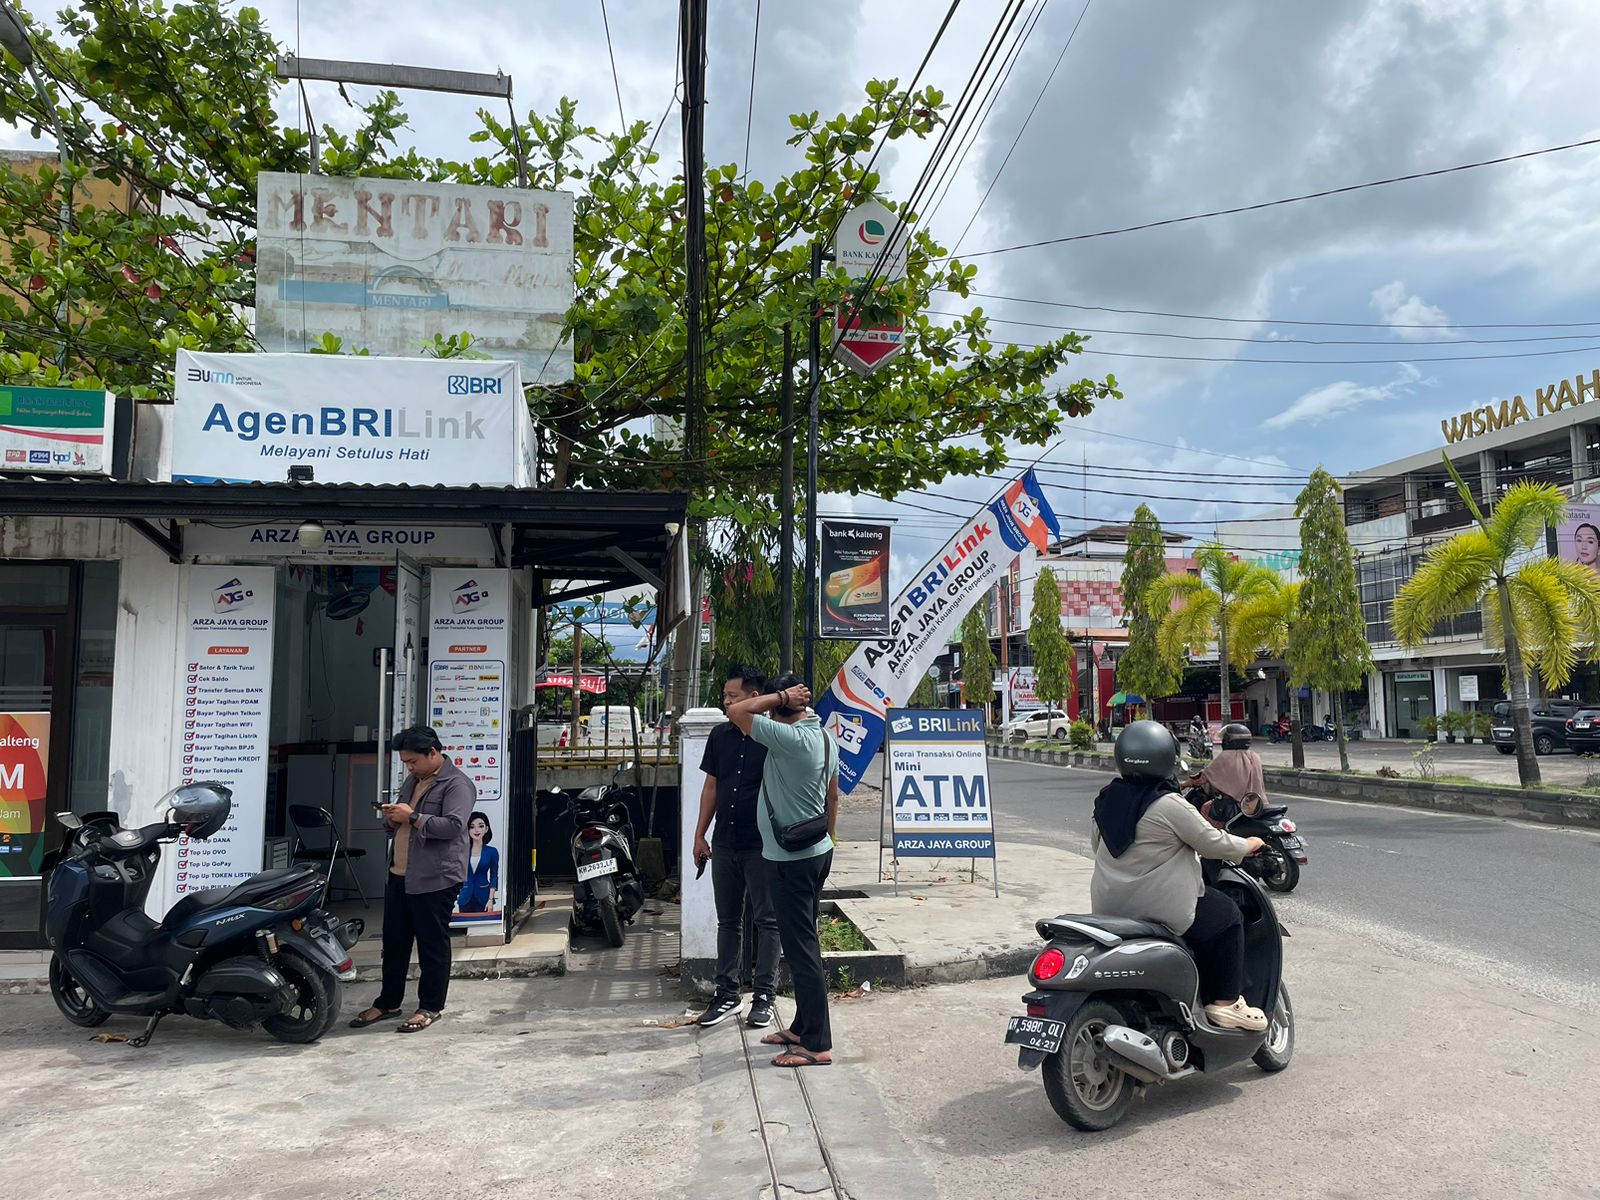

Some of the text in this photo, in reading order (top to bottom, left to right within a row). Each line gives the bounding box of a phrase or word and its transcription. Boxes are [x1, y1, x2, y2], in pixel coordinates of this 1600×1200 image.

[264, 186, 550, 248] MENTARI
[372, 295, 432, 307] MENTARI
[469, 377, 502, 394] BRI
[202, 402, 485, 441] AgenBRILink
[1441, 395, 1530, 444] WISMA
[260, 445, 430, 460] Melayani Setulus Hati
[366, 530, 435, 544] GROUP
[856, 530, 883, 540] kalteng
[887, 550, 990, 673] ARZA JAYA GROUP
[912, 626, 937, 657] Transaksi
[936, 593, 966, 628] Keuangan
[964, 563, 997, 596] Terpercaya
[919, 718, 980, 732] BRILink
[895, 762, 920, 771] Mini
[896, 775, 986, 808] ATM
[897, 840, 991, 849] ARZA JAYA GROUP
[1020, 1020, 1043, 1033] 5980
